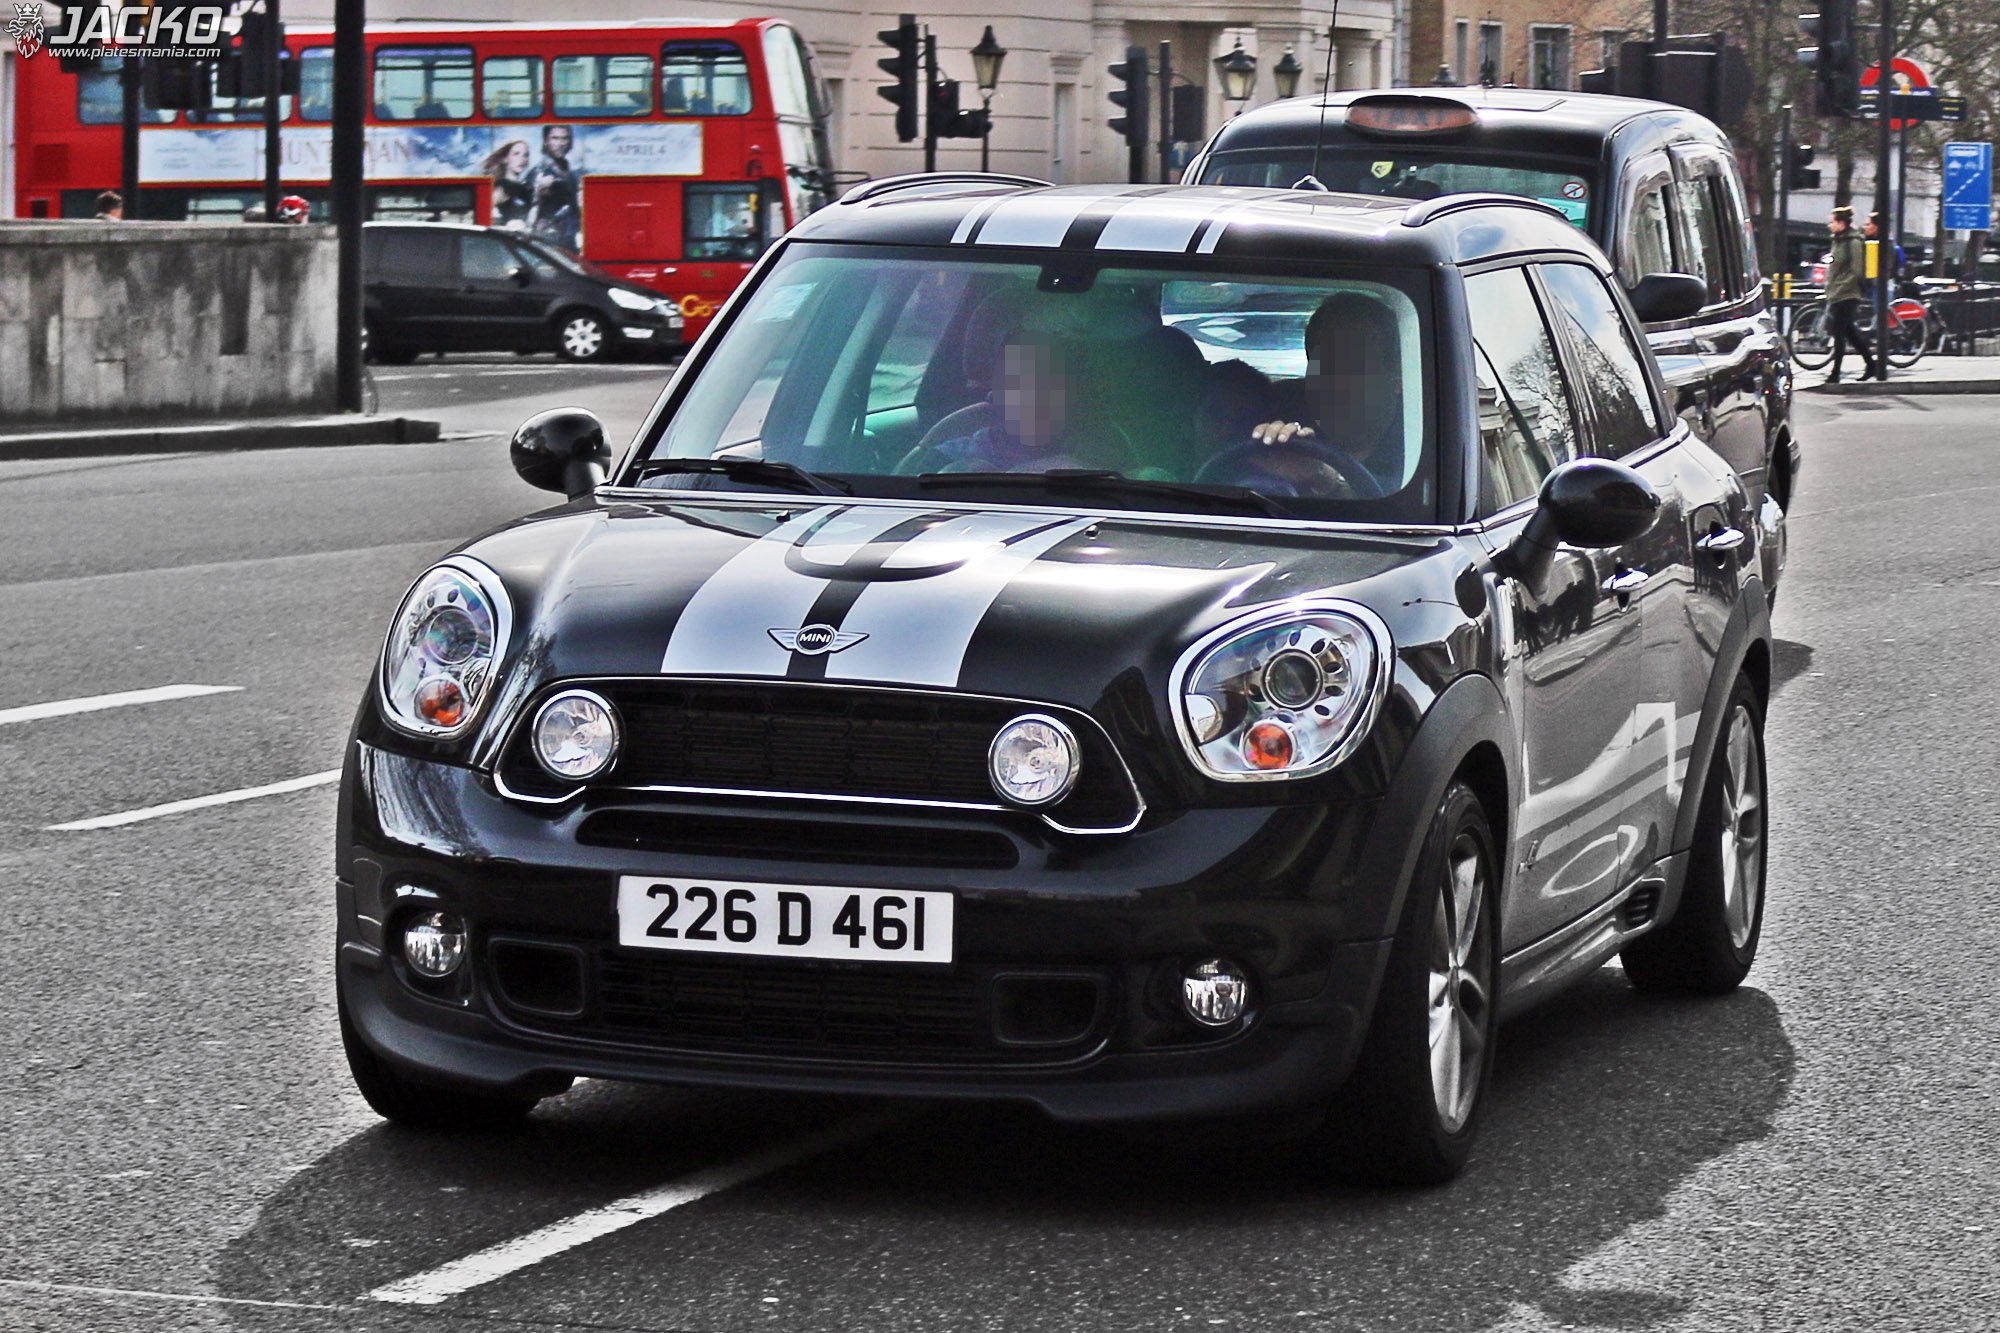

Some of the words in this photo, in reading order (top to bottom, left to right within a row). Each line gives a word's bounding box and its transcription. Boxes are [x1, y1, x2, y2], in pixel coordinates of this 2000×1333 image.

[799, 633, 831, 643] MINI
[645, 883, 757, 943] 226
[777, 891, 812, 946] D
[832, 894, 926, 951] 461
